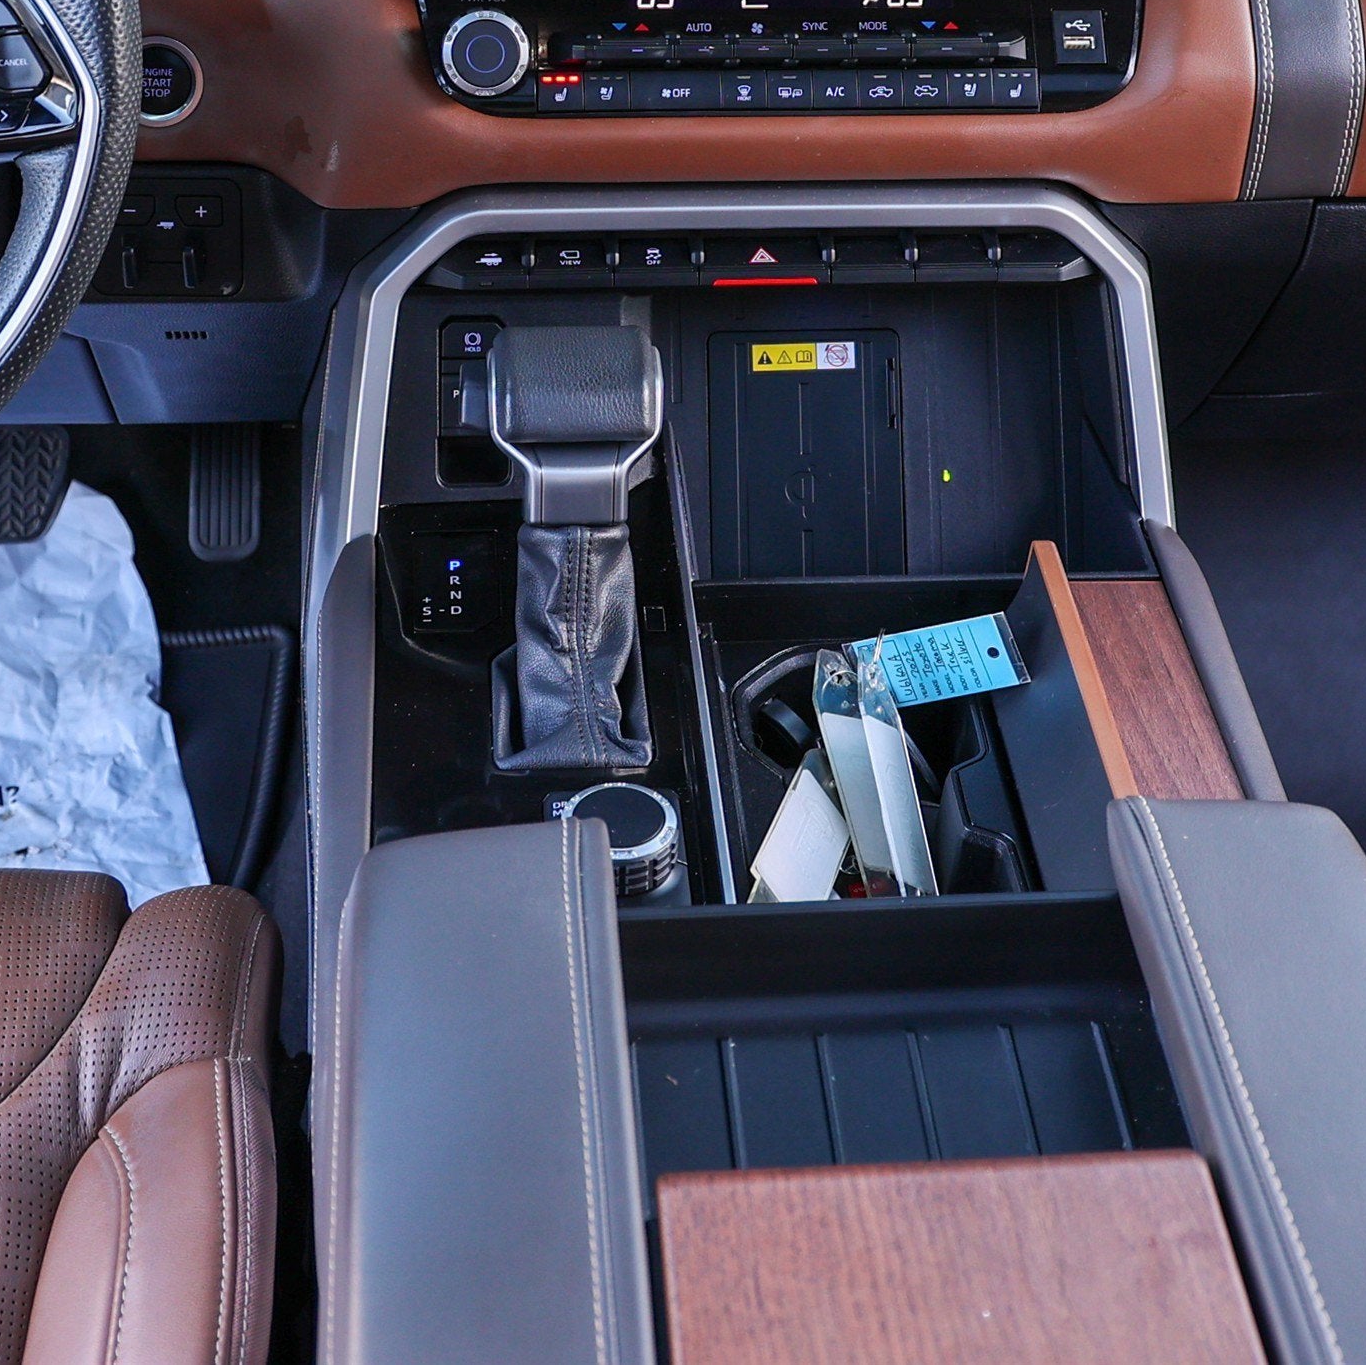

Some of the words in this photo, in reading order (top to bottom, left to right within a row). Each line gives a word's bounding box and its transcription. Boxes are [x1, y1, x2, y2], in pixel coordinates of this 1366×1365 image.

[686, 23, 712, 32] AUTO
[802, 22, 828, 31] SYNC
[859, 22, 888, 31] MODE
[141, 78, 172, 87] START
[144, 88, 171, 97] STOP
[672, 88, 691, 98] OFF
[826, 87, 845, 98] A/C
[450, 561, 461, 570] P
[450, 576, 461, 585] R
[450, 591, 462, 600] N
[423, 606, 432, 616] S
[451, 606, 462, 615] D
